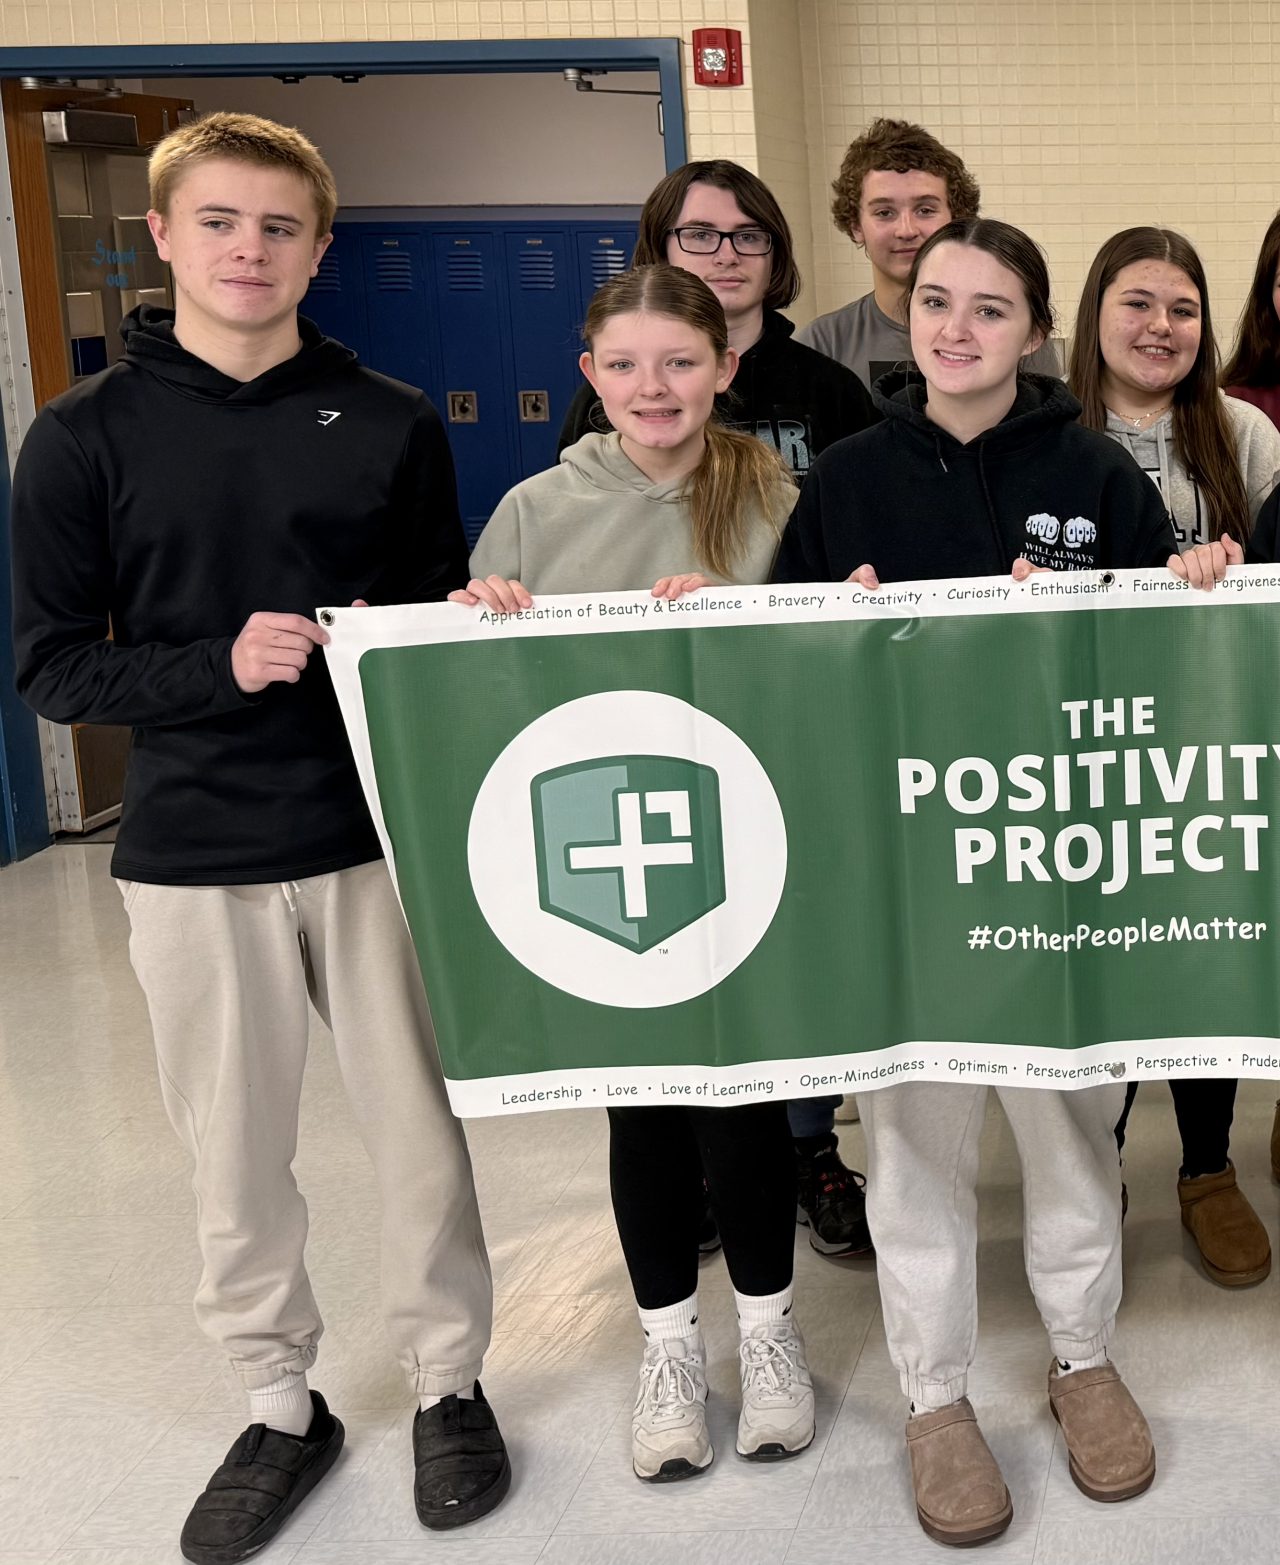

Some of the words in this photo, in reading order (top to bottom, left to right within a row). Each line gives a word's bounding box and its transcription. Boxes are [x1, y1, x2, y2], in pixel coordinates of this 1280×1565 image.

[1020, 552, 1047, 565] HAVE
[1050, 559, 1067, 569] MY
[1025, 542, 1051, 556] WILL
[1052, 550, 1094, 564] ALWAYS
[479, 606, 572, 626] Appreciation
[577, 603, 593, 618] of
[599, 602, 648, 617] Beauty
[653, 600, 664, 613] &
[668, 597, 743, 613] Excellence
[768, 594, 826, 609] Bravery
[852, 591, 923, 605] Creativity
[947, 586, 1011, 601] Curiosity
[1031, 582, 1109, 595] Enthusiasm
[1133, 579, 1189, 592] Fairness
[1061, 696, 1155, 740] THE
[955, 815, 1269, 895] PROJECT
[968, 916, 1267, 952] #OtherPeopleMatter
[502, 1086, 582, 1105] Leadership
[606, 1084, 638, 1097] Love
[661, 1082, 692, 1095] Love
[695, 1082, 709, 1096] of
[713, 1080, 774, 1097] Learning
[800, 1059, 925, 1090] Open-Mindedness
[948, 1058, 1008, 1074] Optimism
[1026, 1062, 1111, 1079] Perseverance
[1136, 1054, 1218, 1072] Perspective
